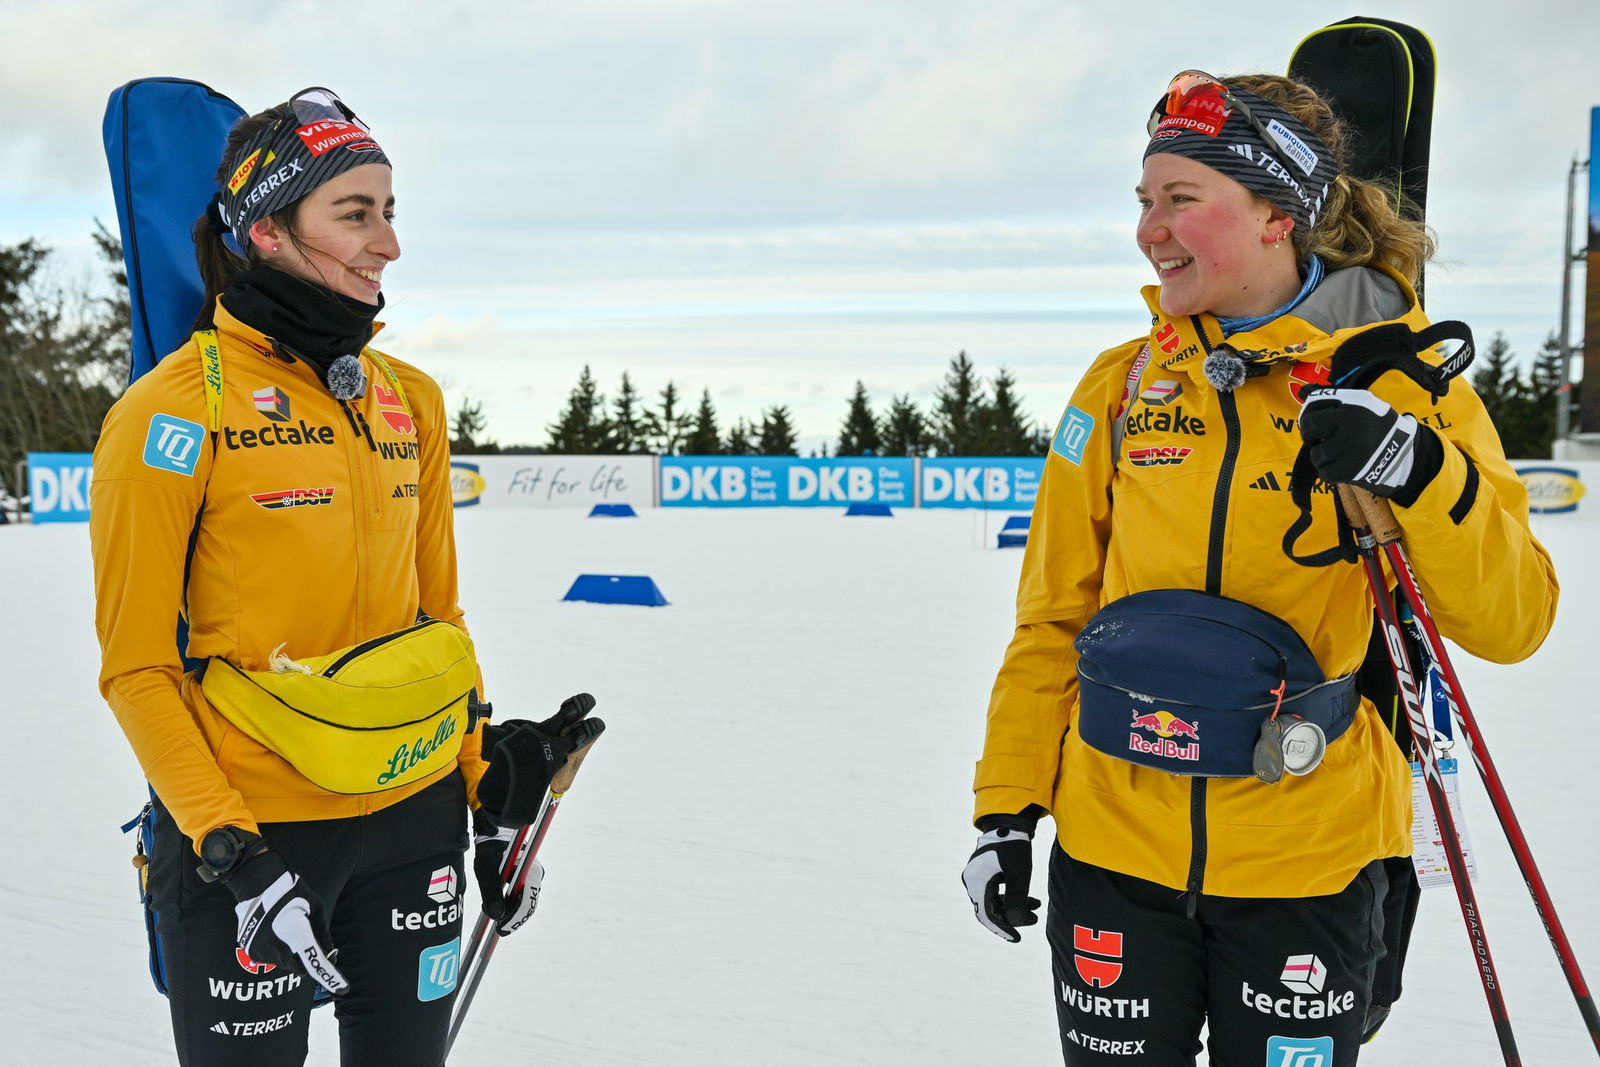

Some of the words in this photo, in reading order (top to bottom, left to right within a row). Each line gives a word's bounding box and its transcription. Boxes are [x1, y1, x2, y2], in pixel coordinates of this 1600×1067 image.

[243, 158, 304, 209] TERREX
[205, 344, 222, 396] Libella
[223, 419, 335, 451] tectake
[1062, 413, 1086, 458] TQ
[1123, 405, 1207, 438] ectake
[157, 422, 195, 469] TQ
[377, 441, 419, 460] WÜRT
[1150, 446, 1194, 466] DSV
[31, 466, 93, 513] DK
[292, 486, 336, 507] DSV
[507, 466, 544, 495] Fit
[547, 467, 581, 502] for
[661, 465, 748, 502] DKB
[787, 465, 875, 502] DKB
[922, 466, 1011, 503] DKB
[377, 713, 457, 785] Libella
[1130, 733, 1163, 756] Red
[1165, 739, 1199, 761] Bull
[391, 893, 465, 931] tectak
[1464, 901, 1481, 938] TRIAC
[1479, 956, 1496, 990] AERO
[208, 972, 302, 1002] WÜRTH
[428, 948, 458, 989] TQ
[1061, 981, 1149, 1019] WÜRTH
[1242, 981, 1354, 1020] tectake
[231, 1010, 294, 1037] TERREX
[1080, 1032, 1146, 1056] TERREX
